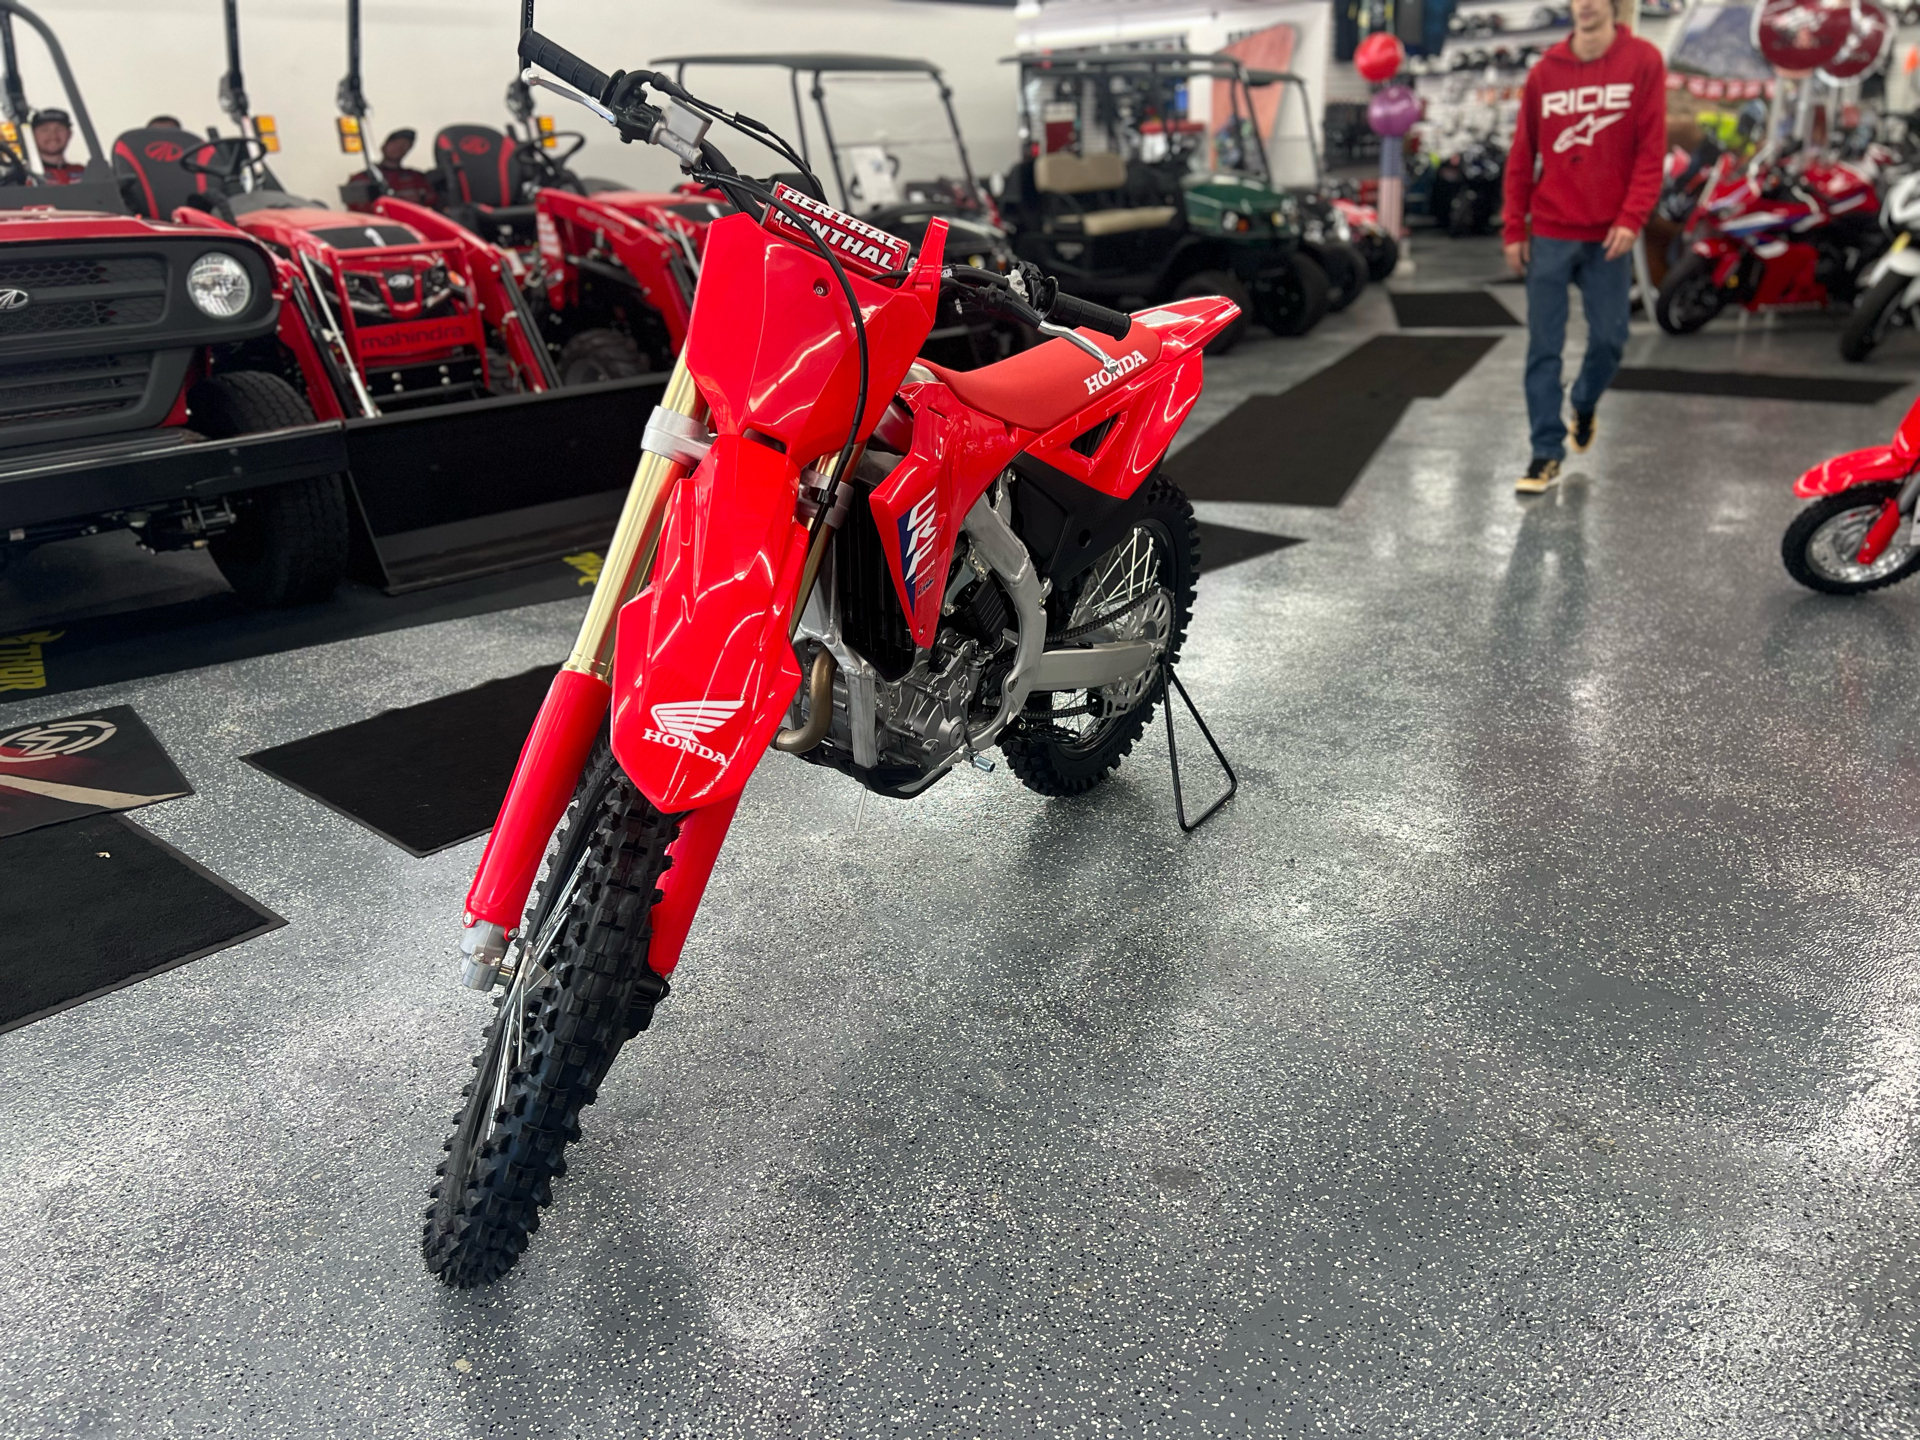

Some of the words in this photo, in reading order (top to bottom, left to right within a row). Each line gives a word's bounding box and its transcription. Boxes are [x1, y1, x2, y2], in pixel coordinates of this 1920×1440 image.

[1541, 83, 1635, 119] RIDE
[781, 188, 900, 250] RENTHAL
[361, 325, 465, 349] mahindra
[1083, 350, 1148, 395] HONDA
[904, 486, 938, 582] CRF
[642, 728, 728, 767] HONDA
